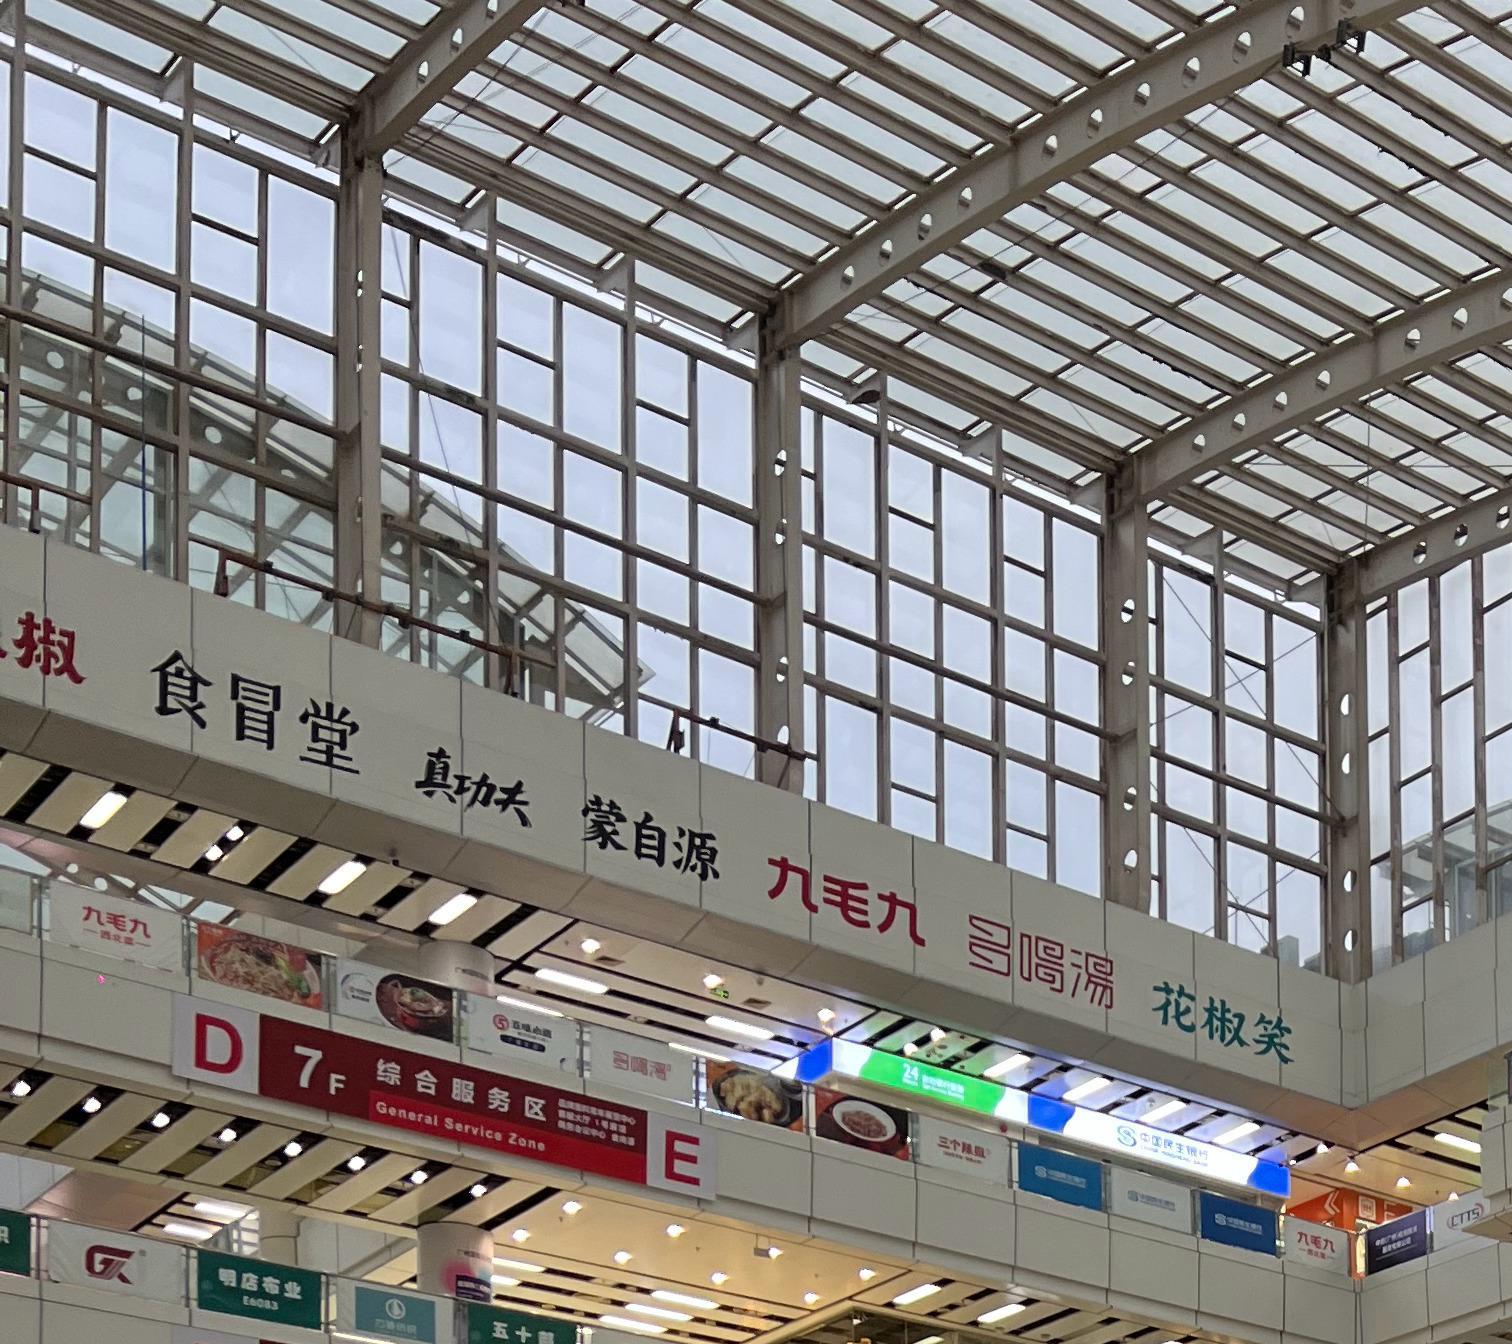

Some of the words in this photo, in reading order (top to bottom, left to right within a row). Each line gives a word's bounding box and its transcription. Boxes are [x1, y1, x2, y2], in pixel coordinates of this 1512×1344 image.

[0, 611, 86, 684] 椒
[150, 649, 361, 776] 食冒堂
[414, 746, 532, 829] 真功夫
[581, 794, 721, 882] 蒙自源
[82, 905, 152, 940] 九毛九
[768, 856, 925, 947] 九毛九
[194, 1013, 243, 1073] D
[1154, 980, 1295, 1065] 花椒笑
[294, 1045, 347, 1096] 7F
[377, 1058, 547, 1120] 综合服务区
[376, 1099, 438, 1127] General
[444, 1115, 502, 1141] Service
[507, 1131, 546, 1152] Zone
[665, 1130, 700, 1185] E
[1297, 1231, 1335, 1254] 九毛九
[1450, 1209, 1480, 1228] CTTS
[218, 1268, 302, 1300] 明店布业
